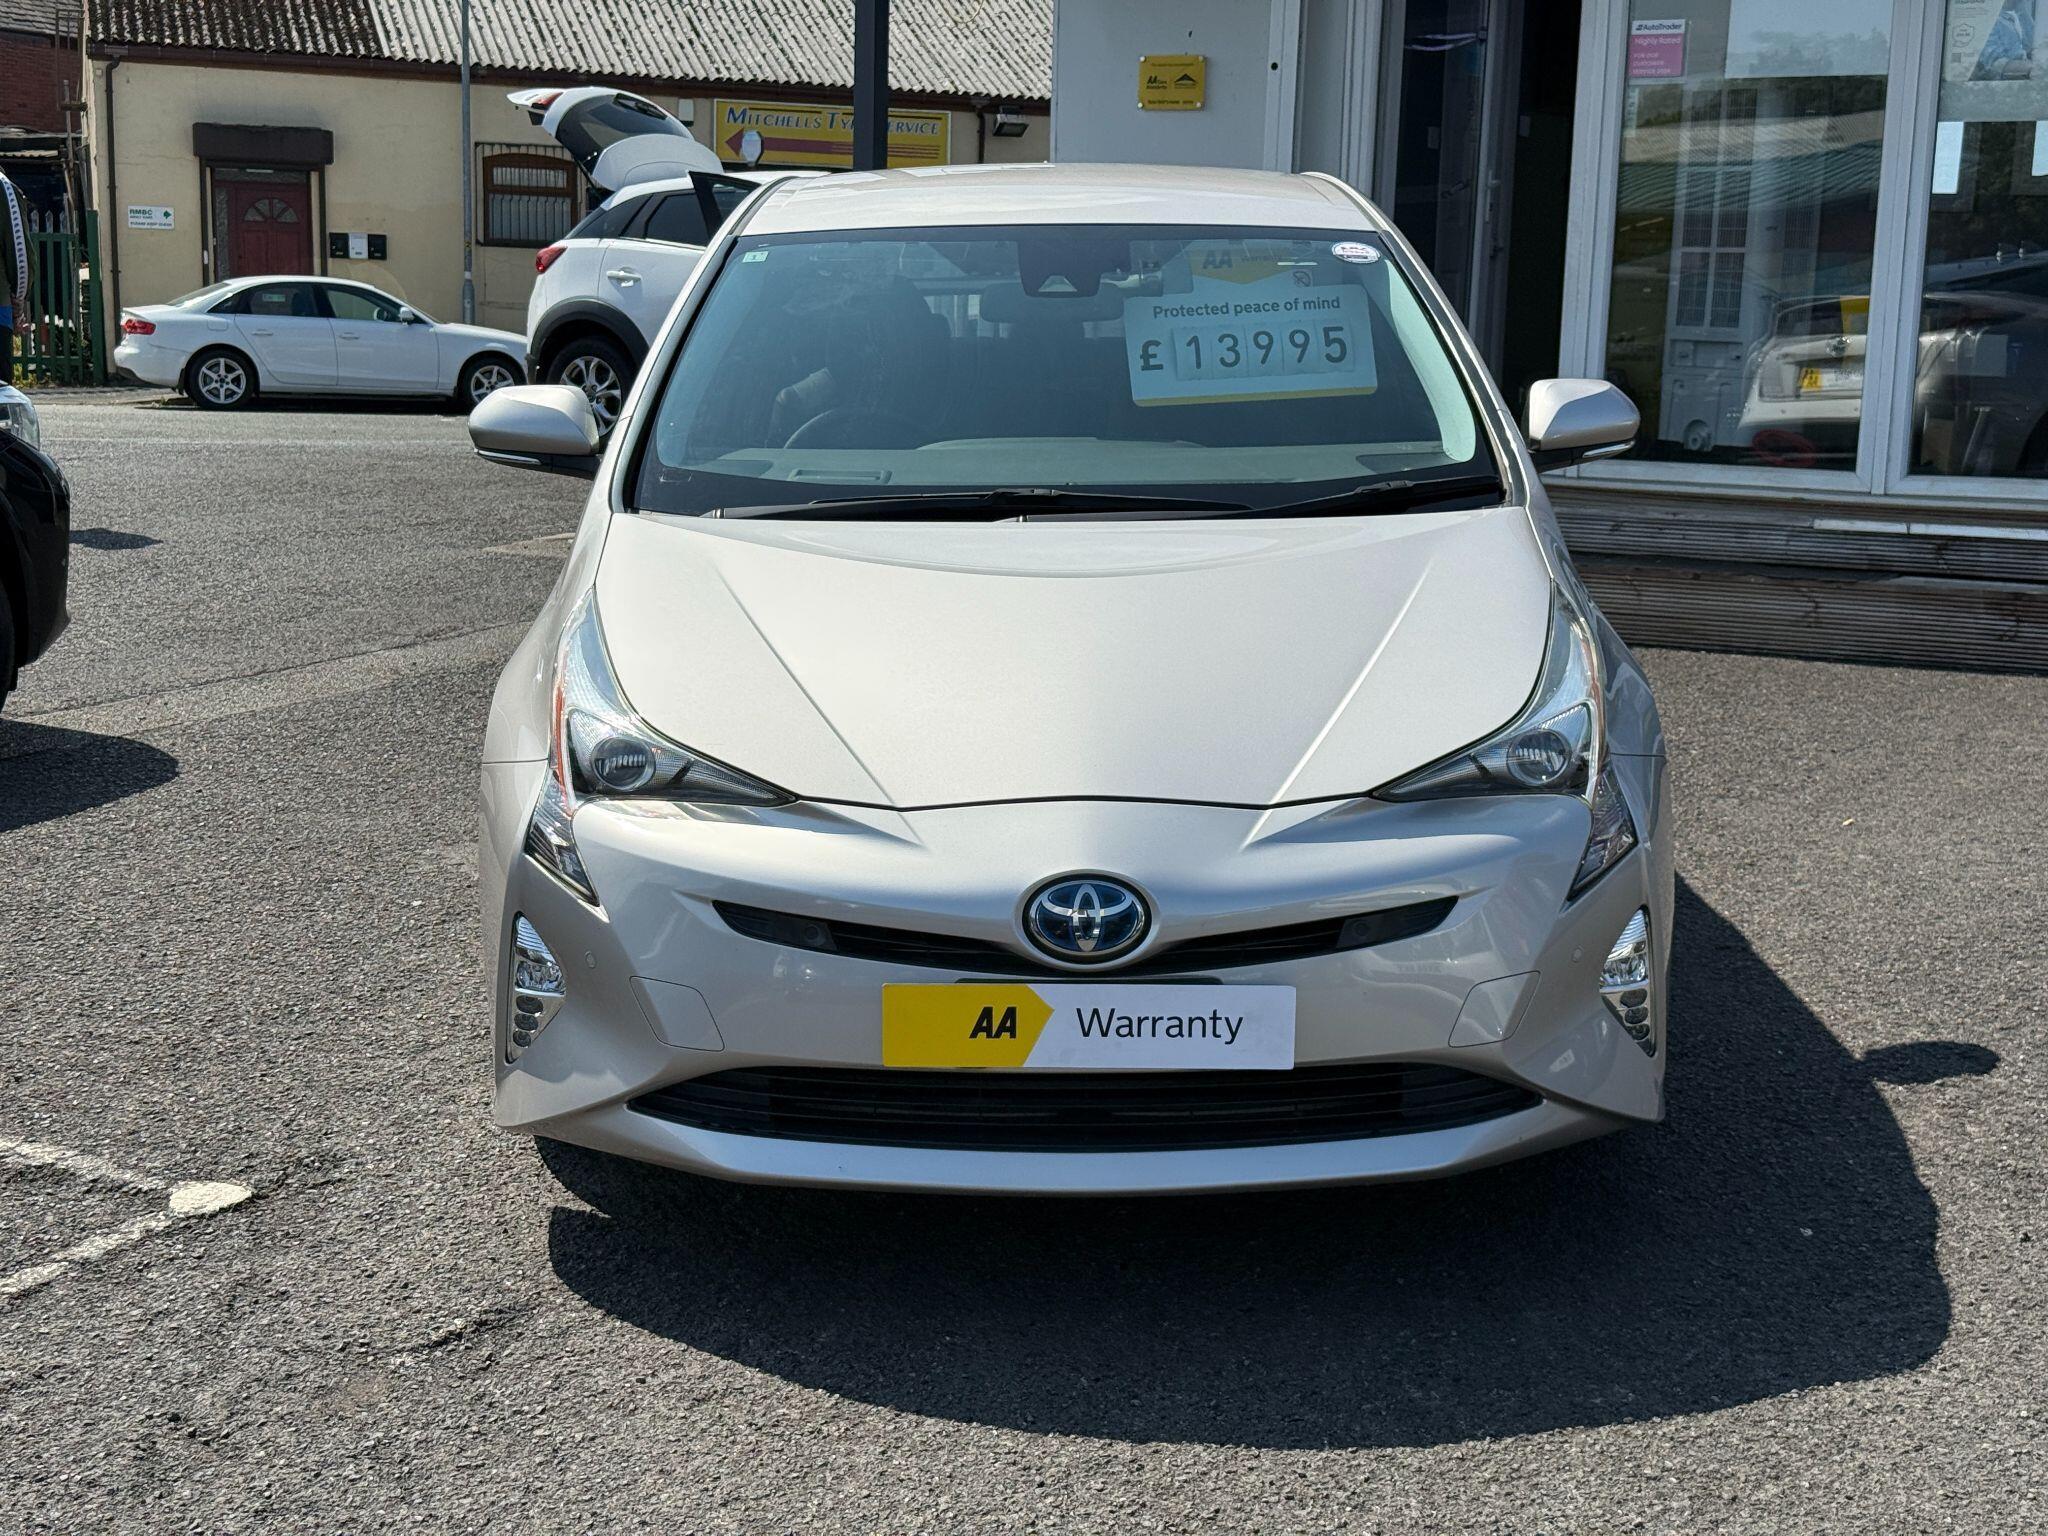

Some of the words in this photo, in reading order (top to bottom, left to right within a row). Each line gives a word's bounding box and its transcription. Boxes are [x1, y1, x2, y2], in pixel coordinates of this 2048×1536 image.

[1640, 22, 1682, 31] AutoTrader
[726, 106, 822, 129] MITCHELLS
[1153, 303, 1229, 318] Protected
[1234, 301, 1280, 317] peace
[1284, 298, 1300, 310] of
[1303, 296, 1341, 310] mind
[969, 1007, 1017, 1039] AA
[1076, 1008, 1244, 1045] Warranty
